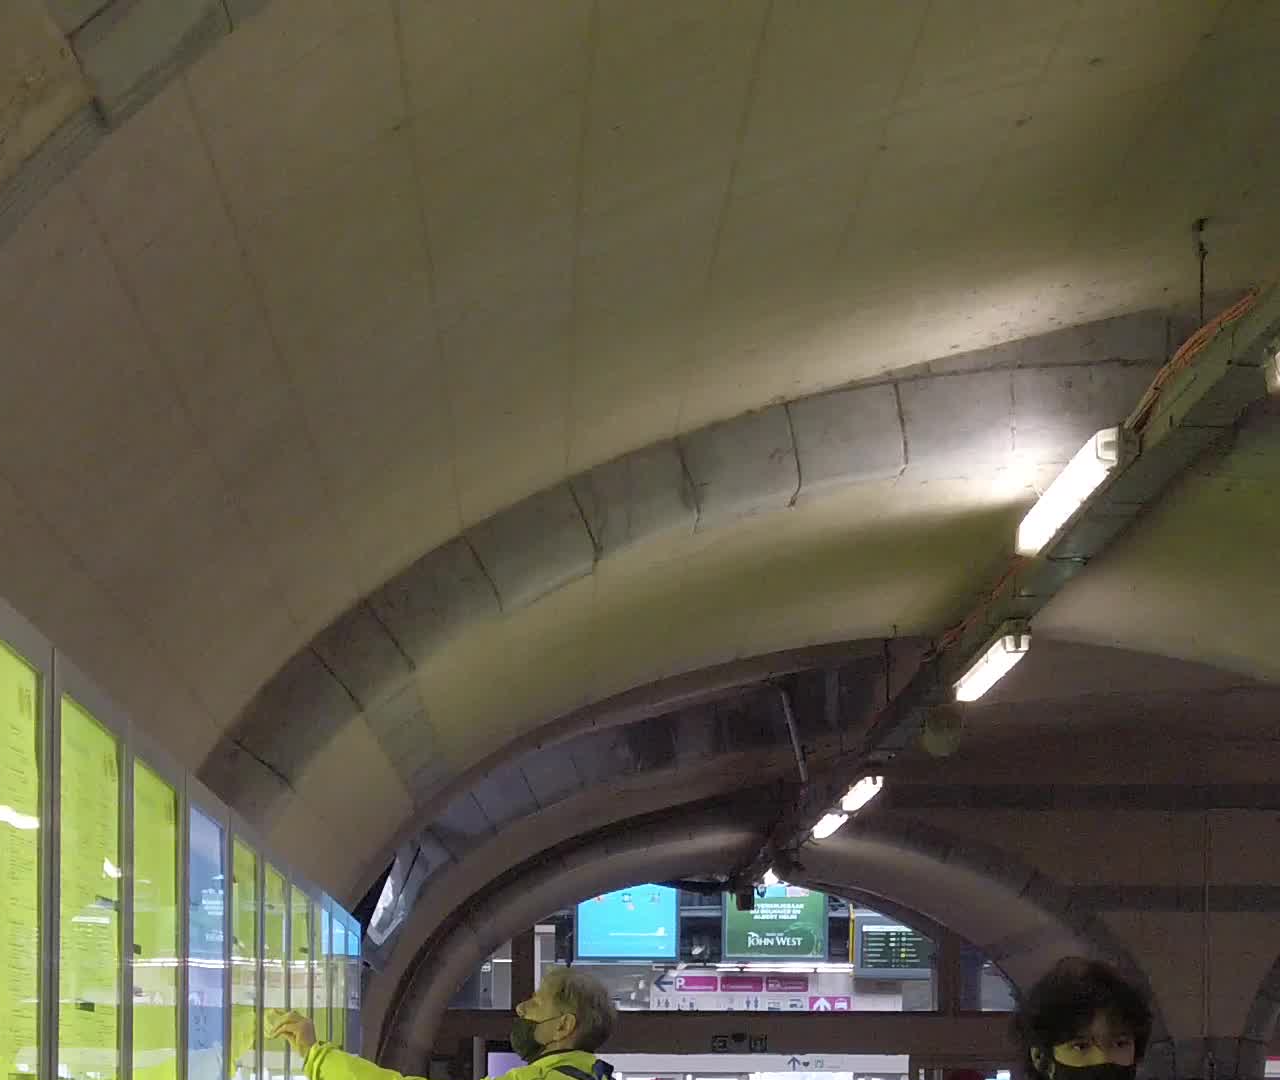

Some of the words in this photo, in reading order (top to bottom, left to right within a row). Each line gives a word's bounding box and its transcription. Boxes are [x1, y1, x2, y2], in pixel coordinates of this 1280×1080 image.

[747, 934, 774, 948] JOHN
[775, 935, 803, 946] WEST
[676, 977, 686, 989] P
